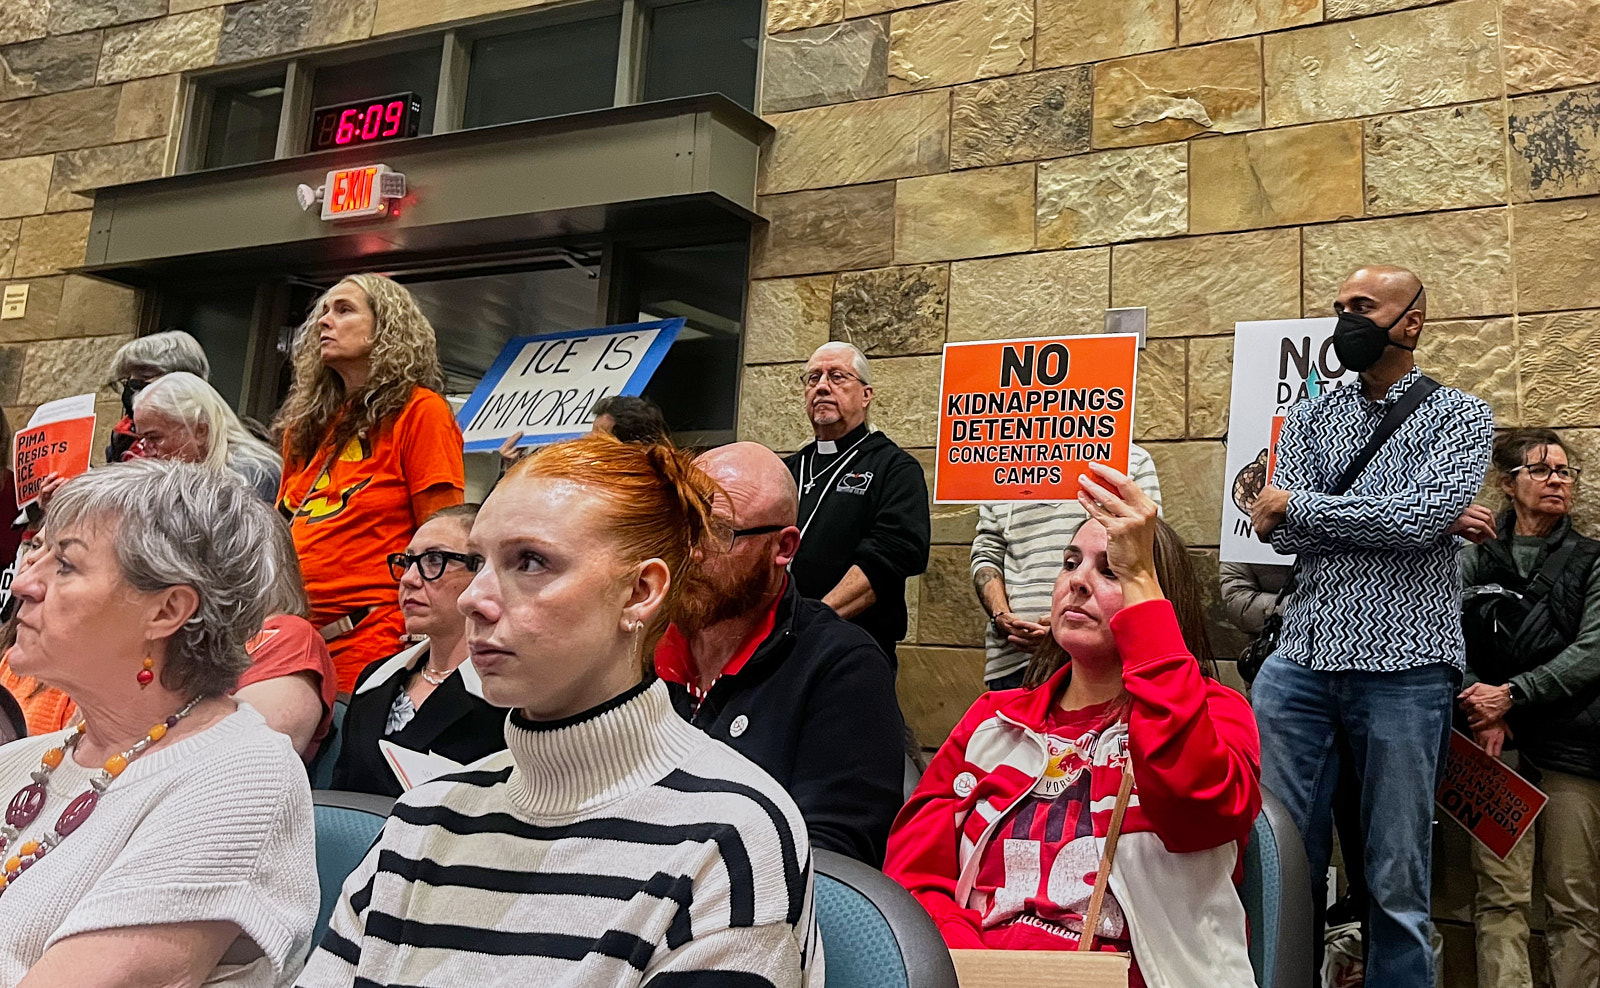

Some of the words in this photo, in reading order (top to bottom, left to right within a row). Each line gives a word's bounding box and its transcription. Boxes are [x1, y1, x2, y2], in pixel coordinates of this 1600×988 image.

[335, 101, 404, 144] 6:09
[331, 167, 377, 213] EXIT
[520, 338, 588, 376] ICE
[592, 335, 639, 372] IS
[1000, 343, 1069, 387] NO
[1279, 336, 1346, 380] NO
[469, 386, 610, 431] IMMORAL
[947, 388, 1125, 416] KIDNAPPINGS
[18, 431, 45, 450] PIMA
[952, 415, 1116, 442] DETENTIONS
[17, 441, 68, 467] RESISTS
[949, 443, 1112, 463] CONCENTRATION
[17, 463, 35, 484] ICE
[994, 467, 1062, 485] CAMPS
[1442, 788, 1483, 830] NO
